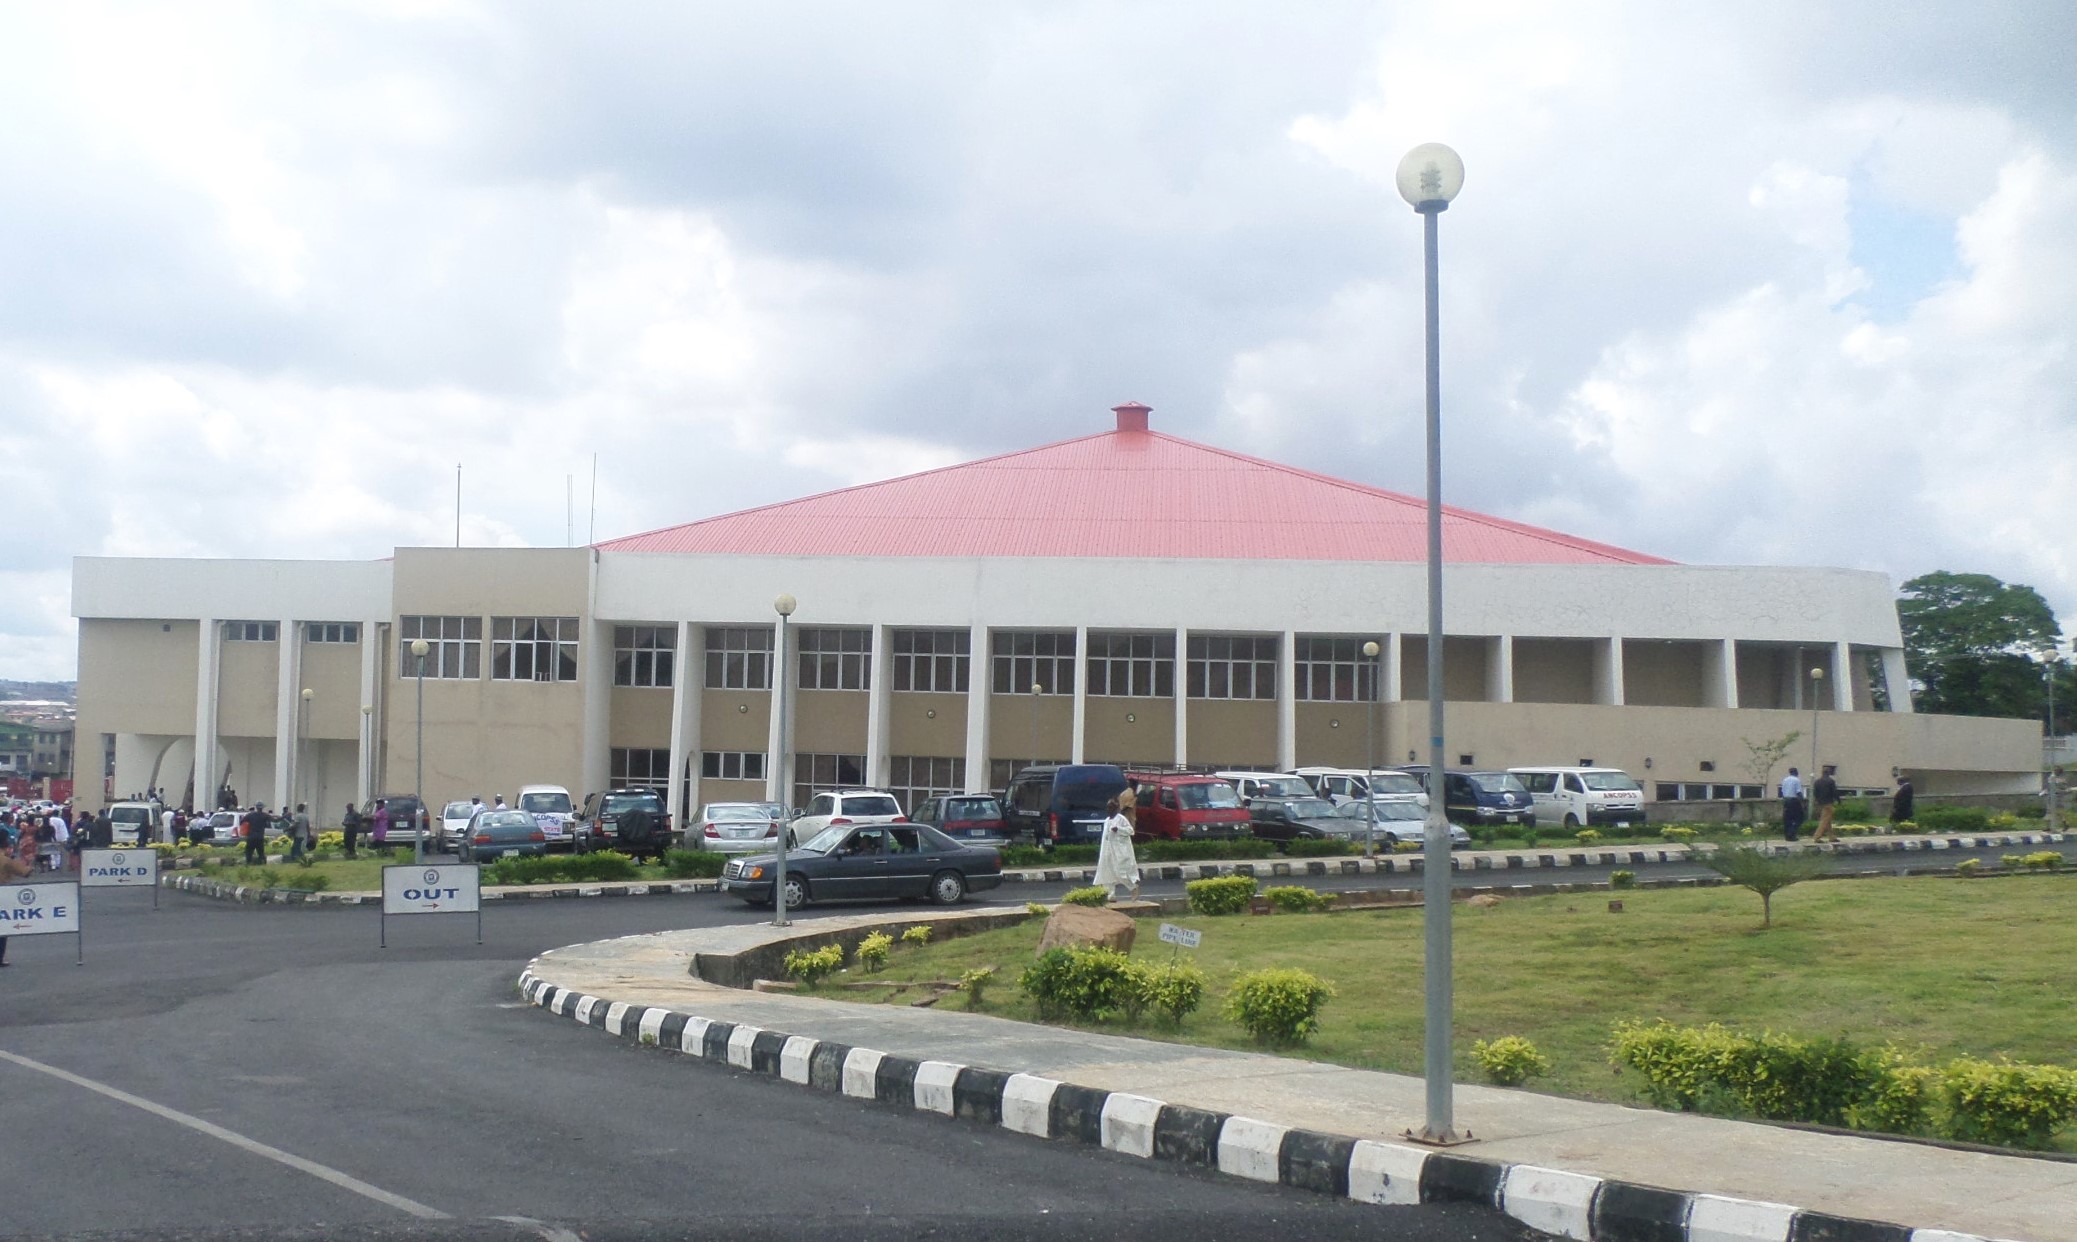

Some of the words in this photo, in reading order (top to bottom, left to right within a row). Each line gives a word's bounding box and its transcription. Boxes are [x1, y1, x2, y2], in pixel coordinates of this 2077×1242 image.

[89, 867, 132, 877] PARK
[137, 867, 148, 876] D
[403, 888, 460, 900] OUT
[53, 906, 67, 918] E
